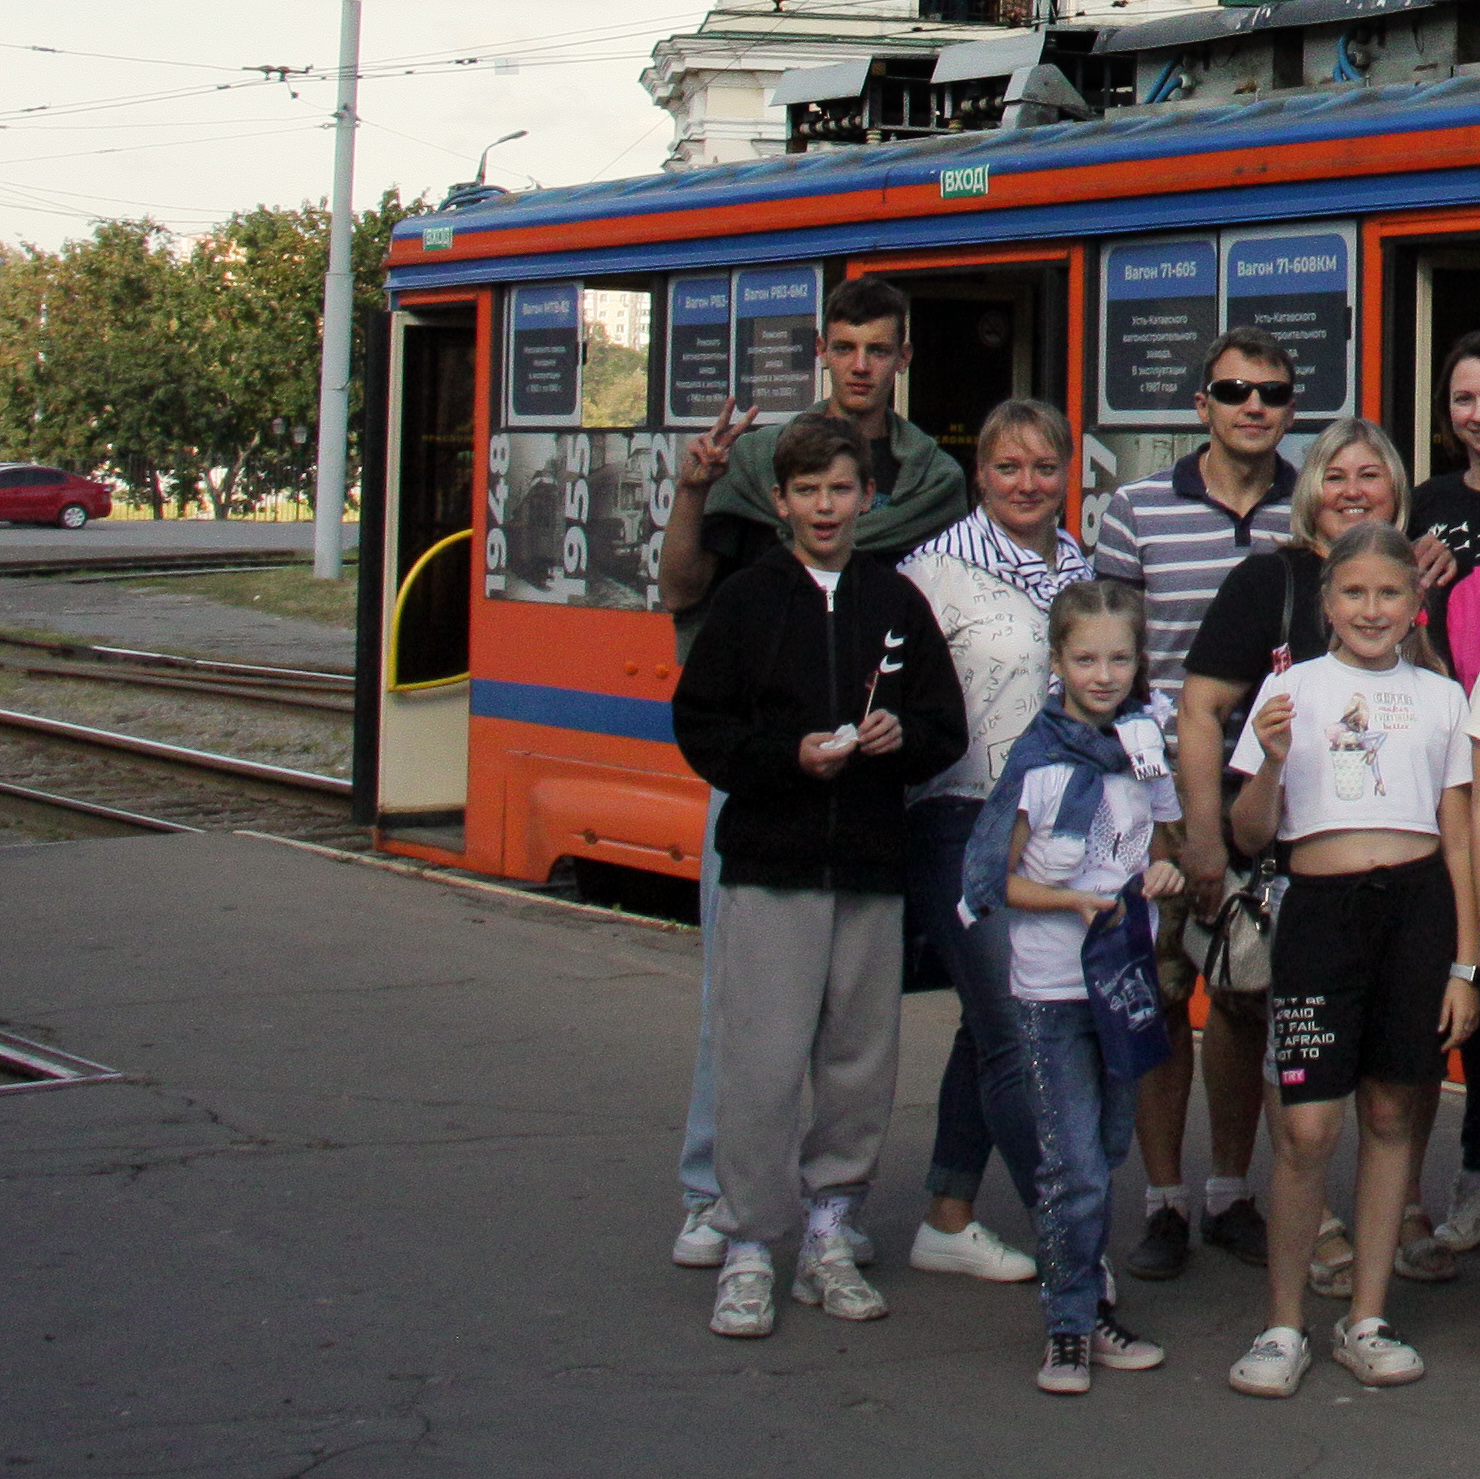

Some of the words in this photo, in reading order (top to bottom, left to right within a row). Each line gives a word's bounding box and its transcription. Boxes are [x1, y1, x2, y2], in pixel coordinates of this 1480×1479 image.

[945, 167, 985, 194] ВХОД
[426, 227, 449, 248] ВХОД
[1124, 264, 1158, 281] Вагон
[1160, 261, 1197, 279] 71-605
[1237, 260, 1273, 277] Вагон
[1276, 255, 1337, 274] 71-608КМ
[685, 296, 709, 309] Вагон
[744, 287, 770, 301] Вагон
[1081, 433, 1118, 547] 87
[485, 434, 511, 598] 1948
[563, 433, 592, 603] 1955
[1305, 995, 1326, 1006] BE
[1285, 1032, 1335, 1046] AFRAID
[1299, 1047, 1320, 1059] TO
